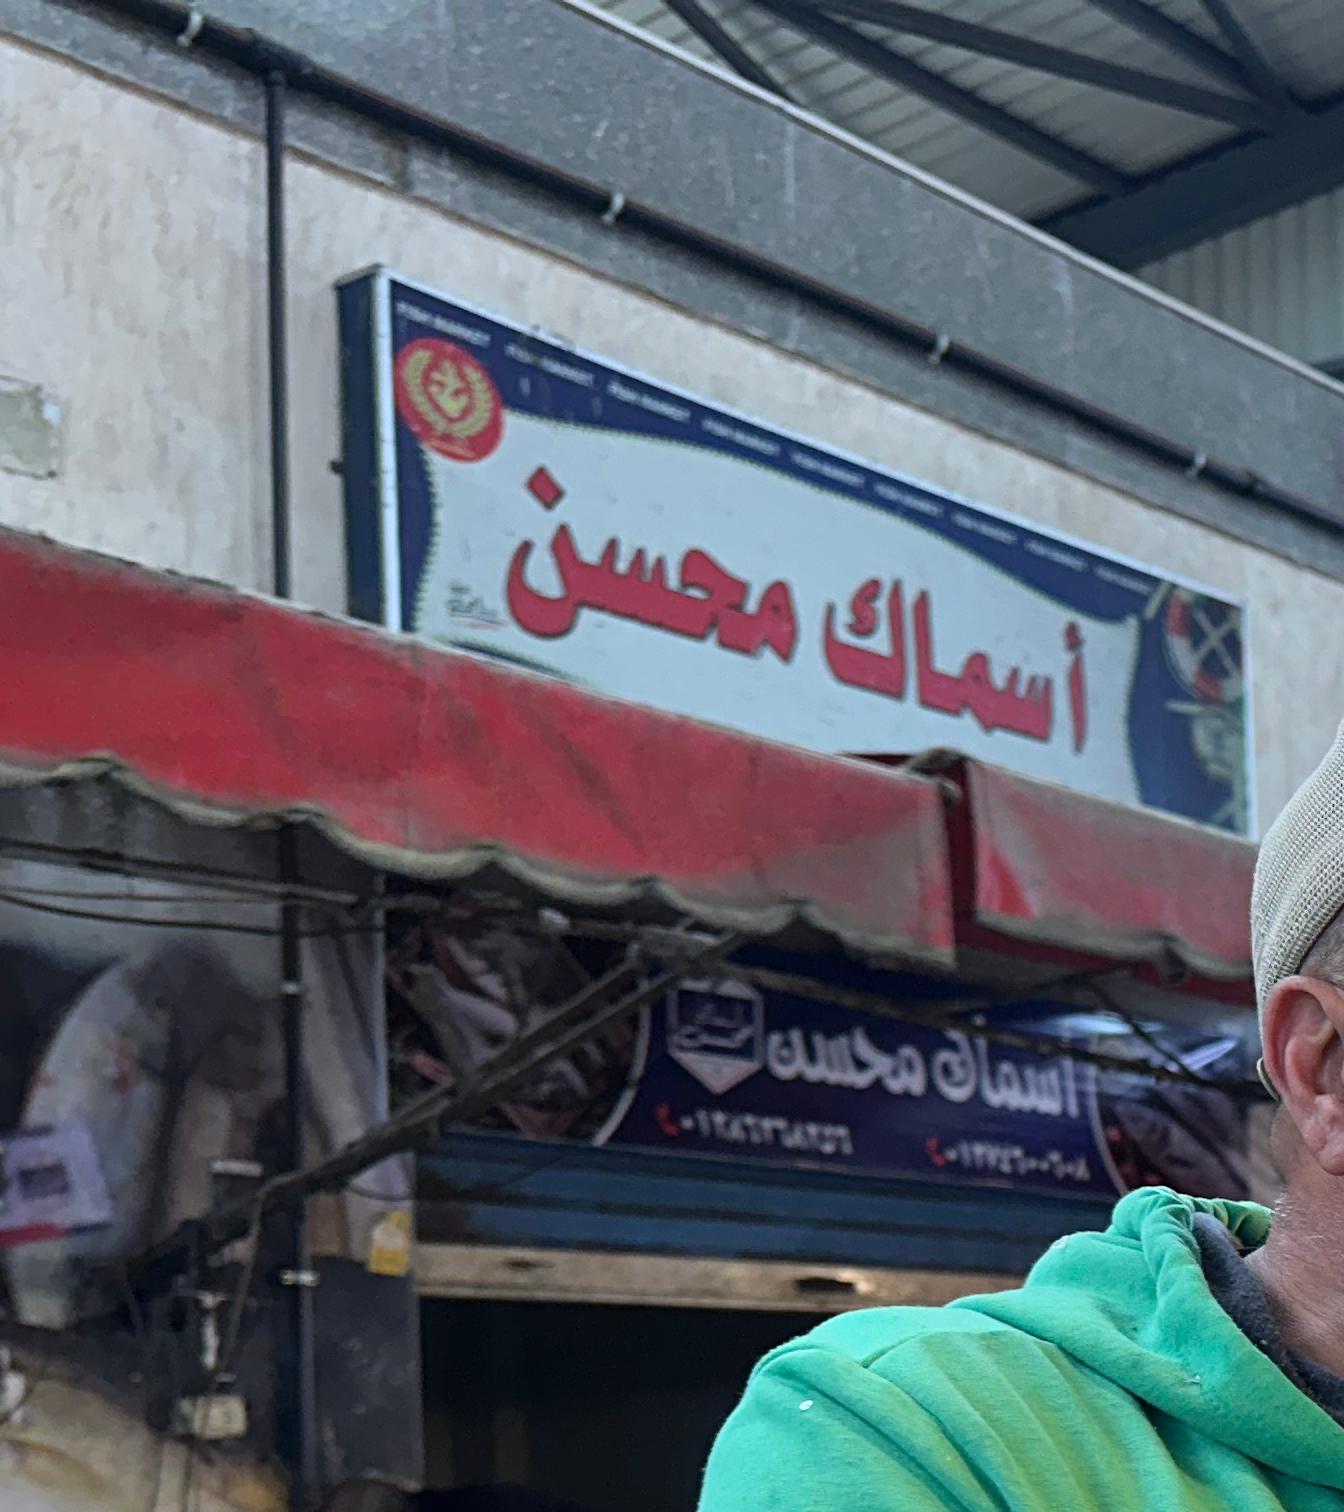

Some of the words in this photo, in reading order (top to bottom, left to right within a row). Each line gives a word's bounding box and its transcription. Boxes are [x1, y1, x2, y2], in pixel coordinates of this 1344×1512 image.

[507, 465, 797, 664] محسن
[823, 577, 1087, 755] أسماك
[767, 1027, 926, 1097] محسن
